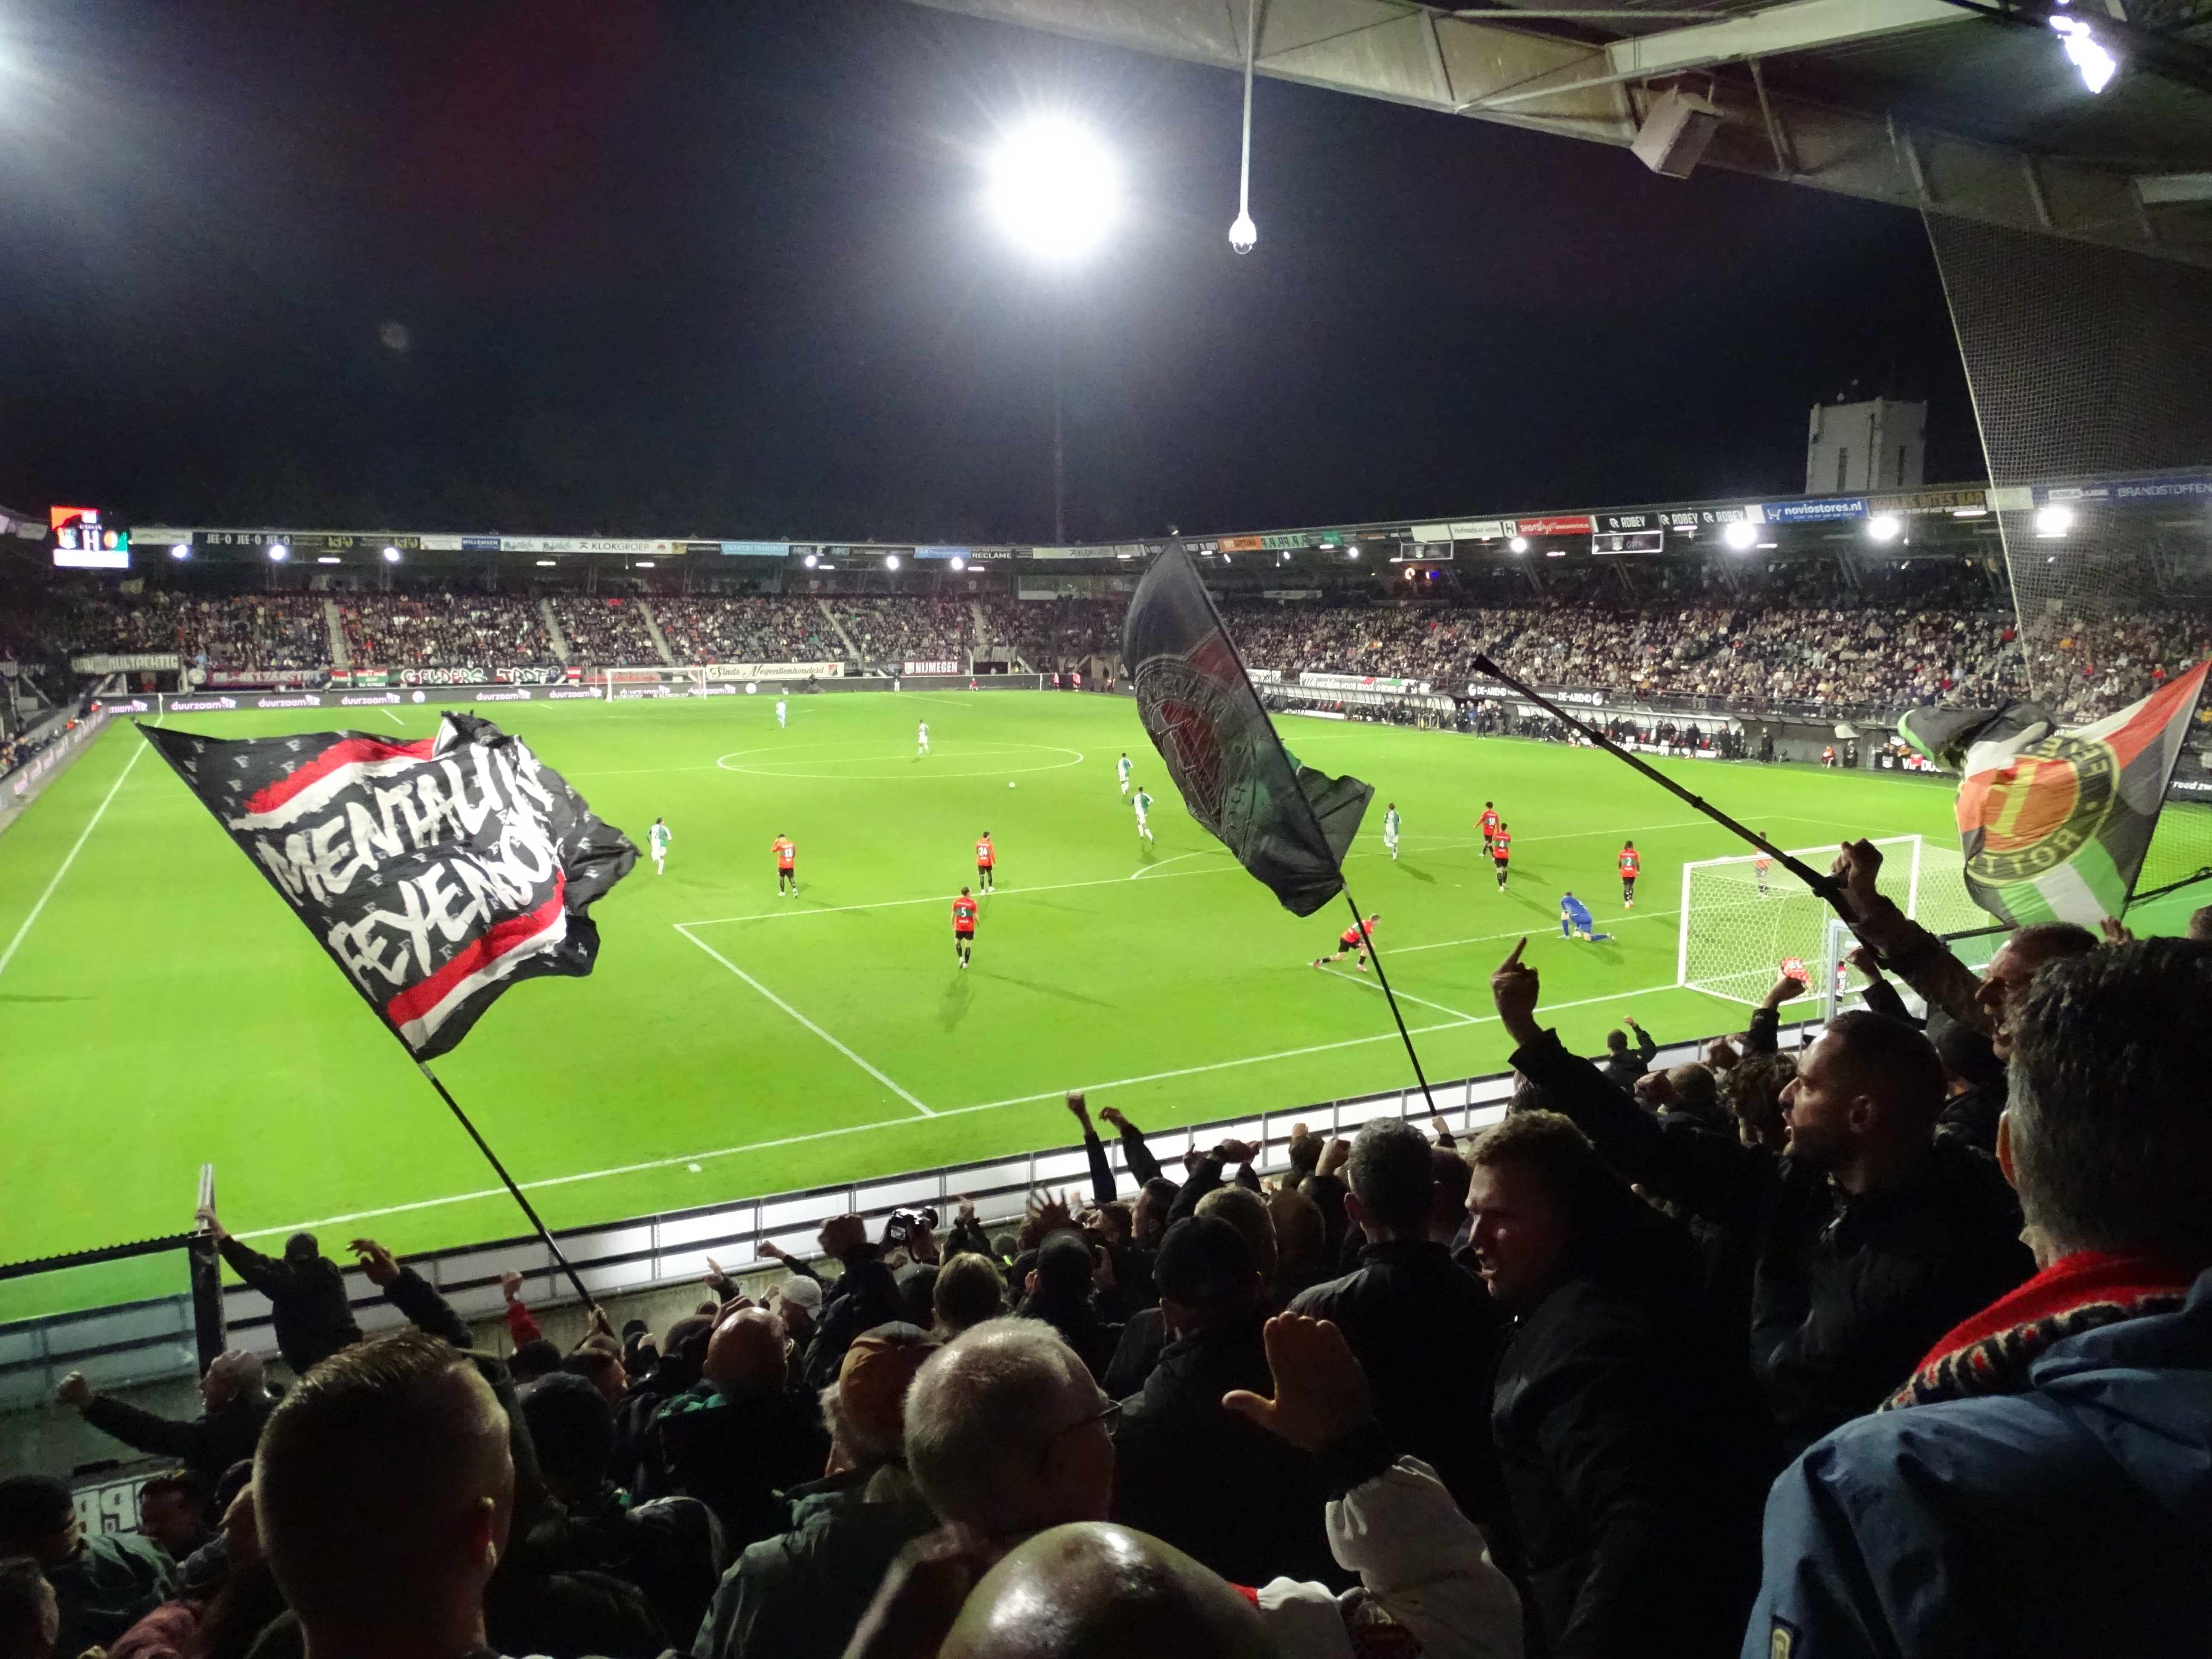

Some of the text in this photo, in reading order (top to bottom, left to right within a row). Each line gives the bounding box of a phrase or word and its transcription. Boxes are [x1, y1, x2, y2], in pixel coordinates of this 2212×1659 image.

[1784, 501, 1863, 516] noviostores.nl
[1671, 513, 1698, 525] ROBEY
[1715, 510, 1744, 523] ROBEY
[1621, 516, 1645, 528] ROBEY
[591, 542, 649, 551] KLOKGROEP
[710, 666, 740, 679] Sinds
[915, 662, 958, 673] NIJMEGEN
[400, 667, 488, 684] GELDERS
[476, 692, 519, 701] duurzaam
[549, 690, 591, 699] duurzaam
[171, 700, 221, 710] duurzaam
[258, 699, 306, 708] duurzaam
[341, 696, 387, 705] duurzaam
[978, 847, 988, 856] 24
[1626, 857, 1631, 866] 2
[961, 907, 966, 917] 5
